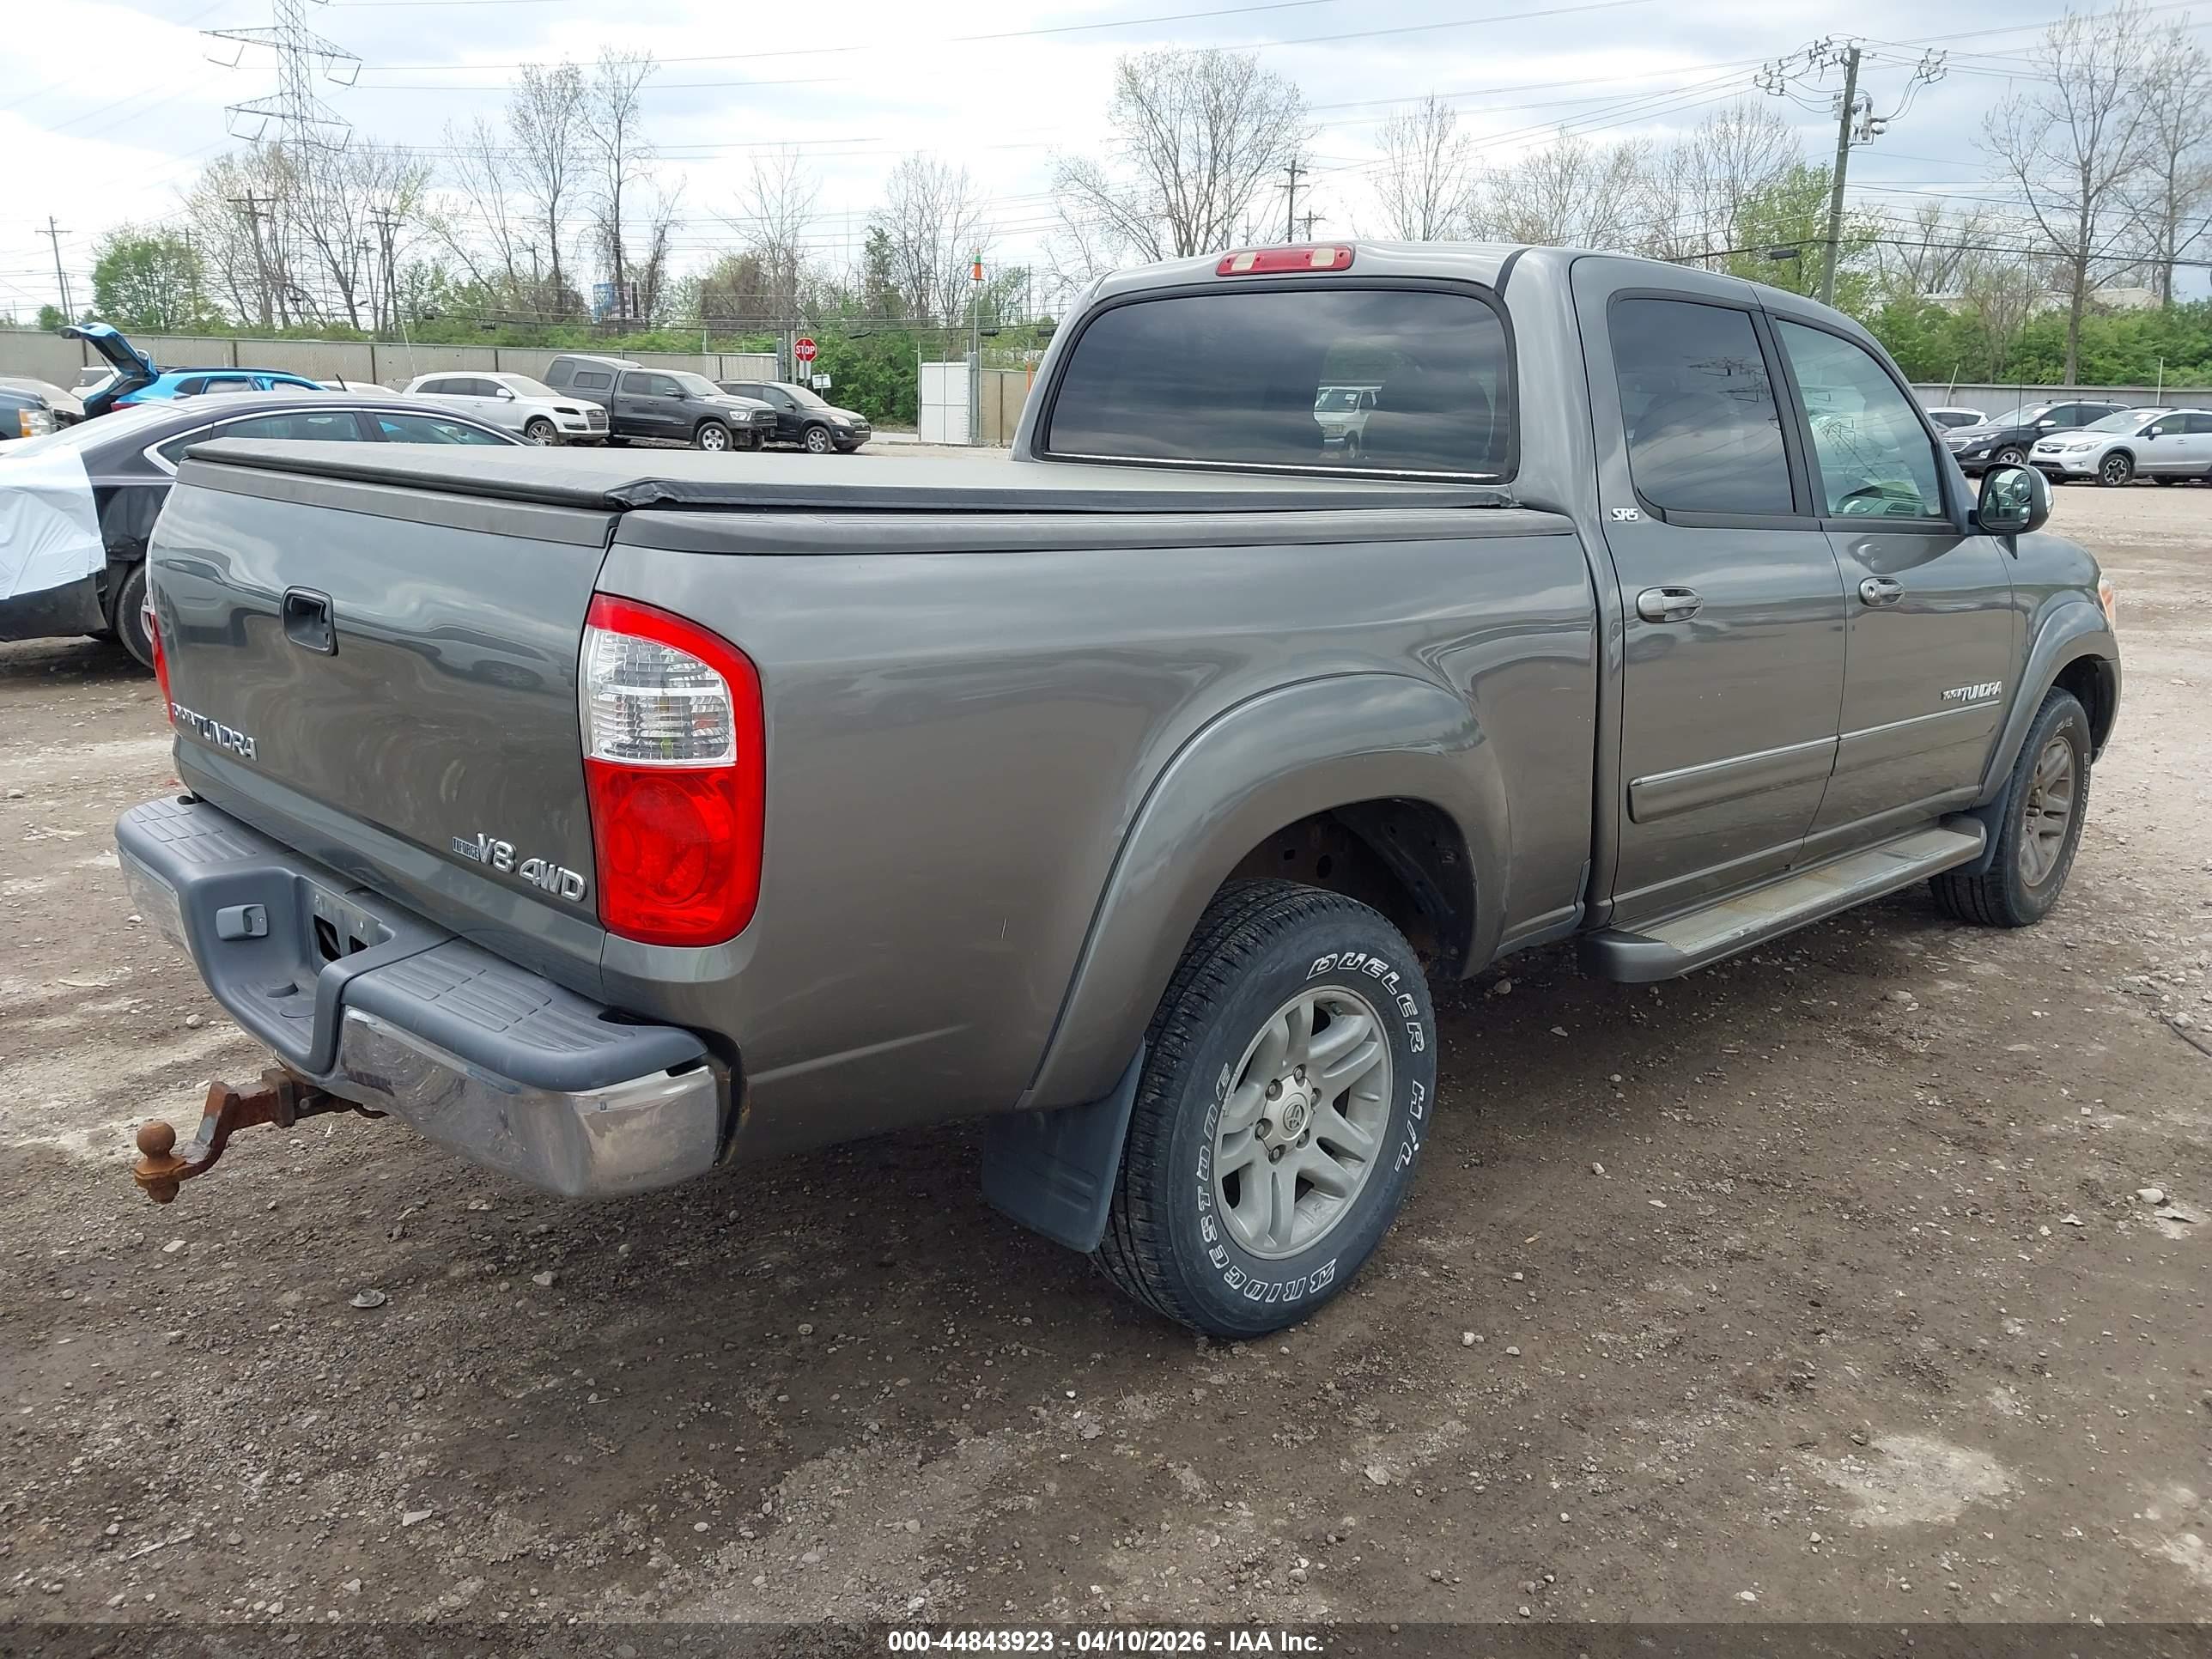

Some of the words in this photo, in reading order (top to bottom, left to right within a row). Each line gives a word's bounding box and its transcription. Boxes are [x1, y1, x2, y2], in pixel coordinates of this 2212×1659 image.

[795, 345, 815, 355] STOP
[1612, 507, 1638, 521] SR5
[194, 713, 258, 761] TUNDRA
[477, 832, 516, 873] V8
[519, 858, 587, 902] 4WD
[1306, 951, 1425, 1054] DUELER
[1196, 1062, 1337, 1304] BRIDGESTONE
